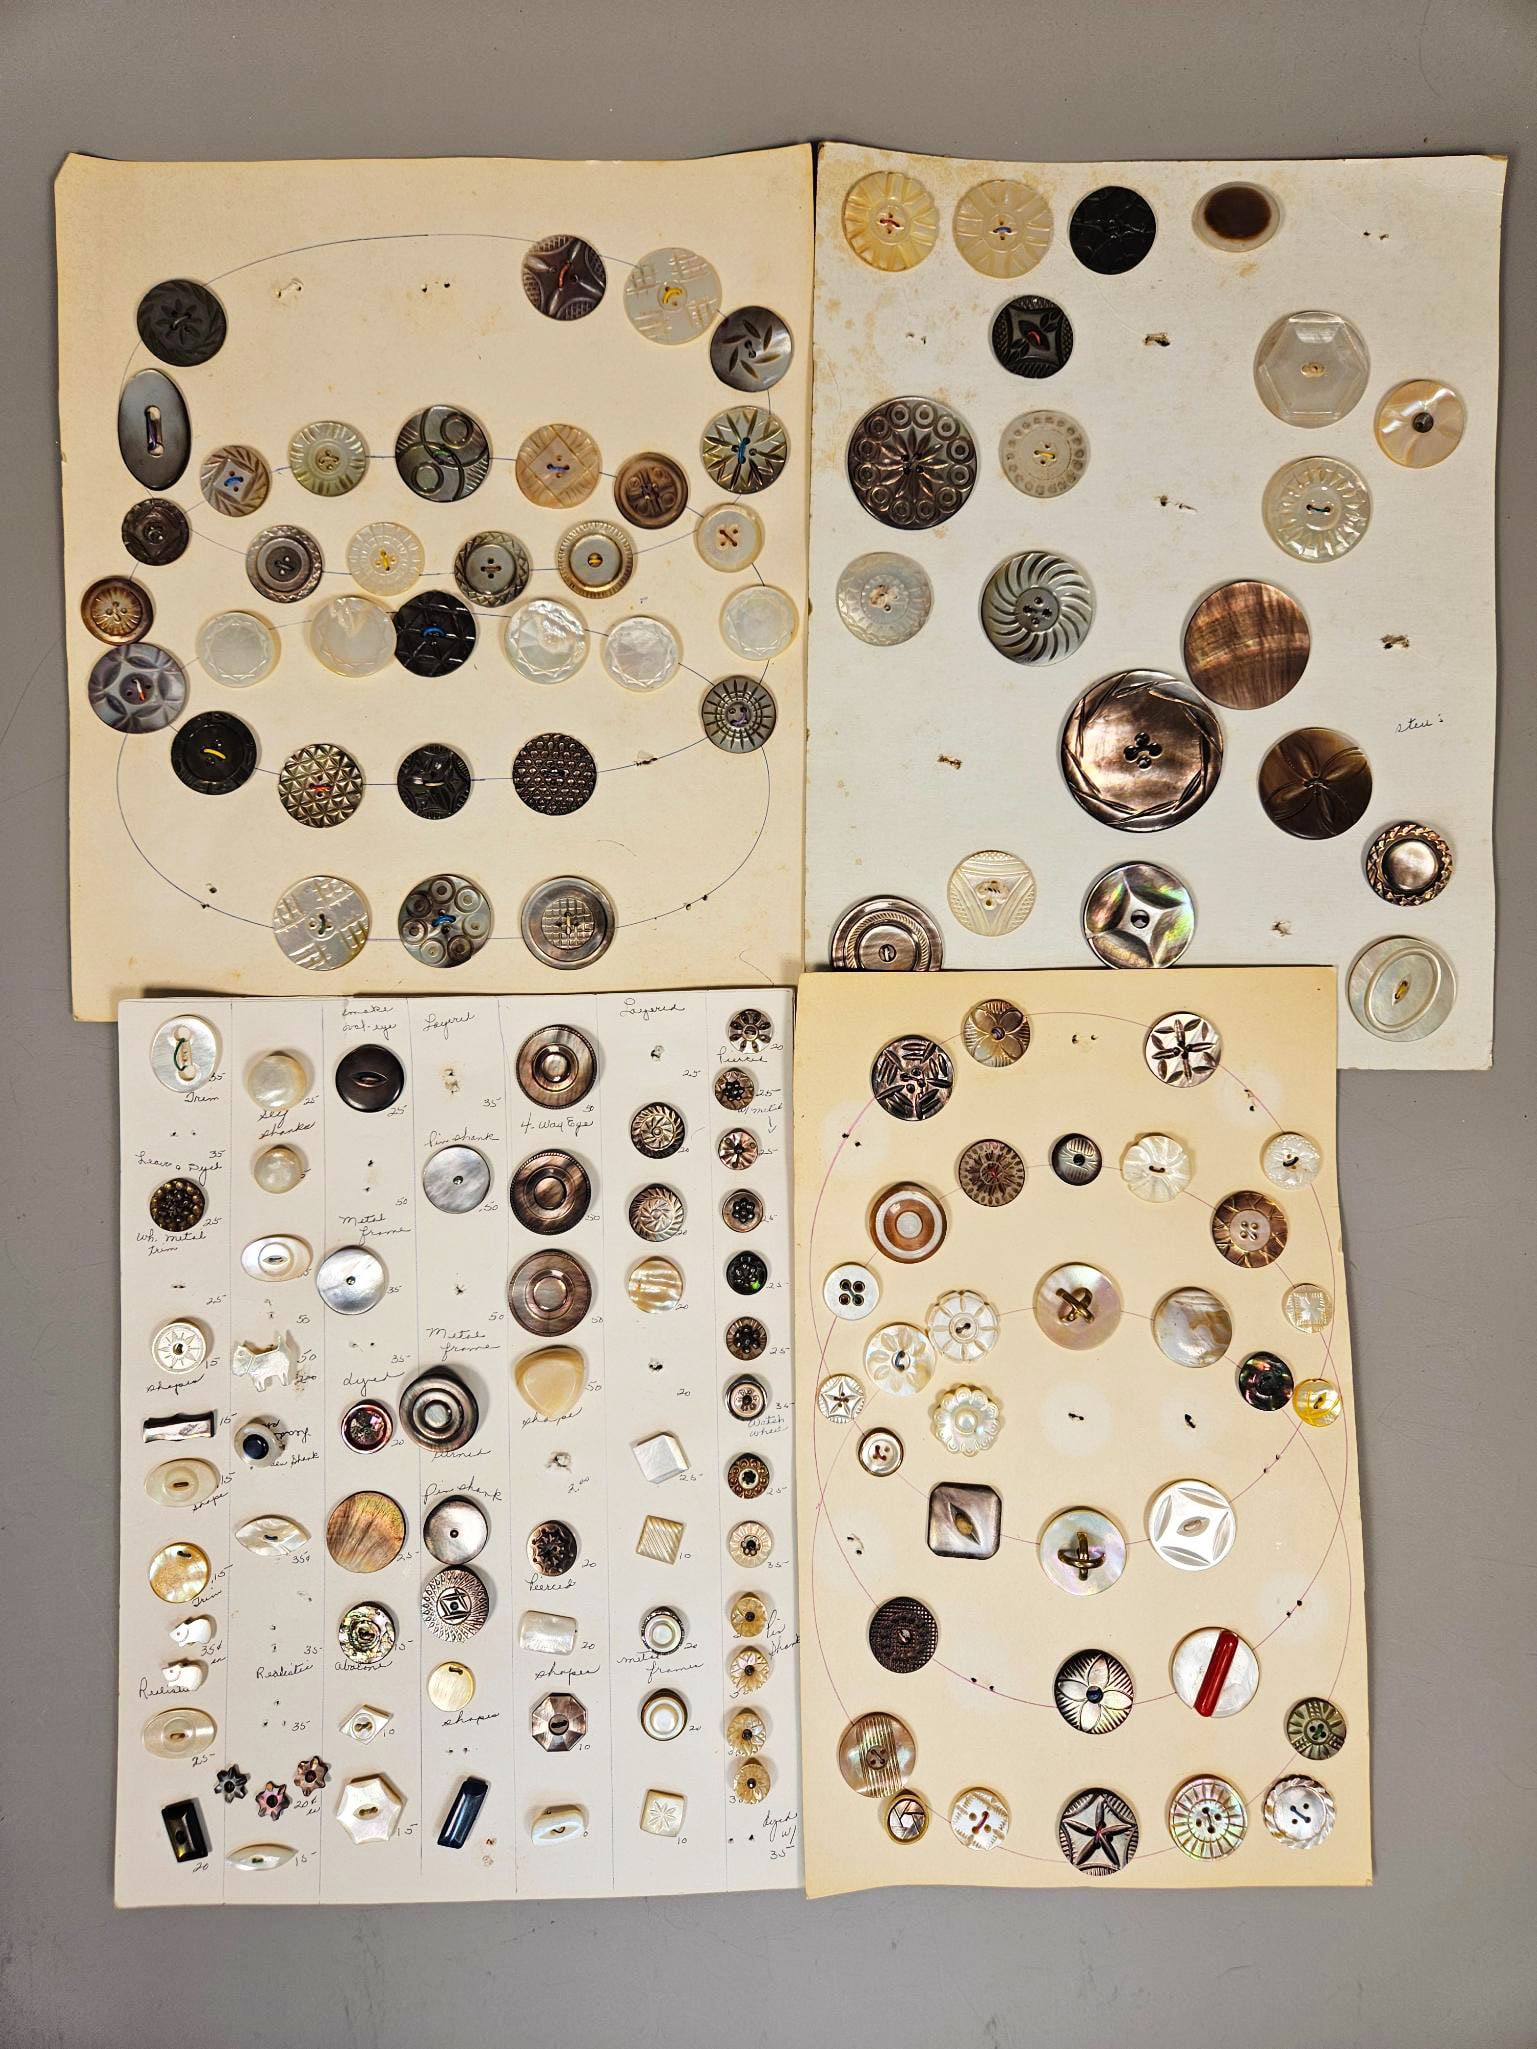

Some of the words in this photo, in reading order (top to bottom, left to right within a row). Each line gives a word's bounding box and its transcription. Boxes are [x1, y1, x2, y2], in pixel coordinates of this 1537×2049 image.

[482, 1096, 502, 1108] 35
[394, 1196, 409, 1206] 50
[488, 1311, 505, 1321] 50
[676, 1388, 691, 1397] 20
[679, 1552, 692, 1560] 10
[581, 1558, 597, 1569] 20
[581, 1641, 596, 1650] 20
[291, 1720, 312, 1732] 35
[677, 1837, 688, 1845] 10
